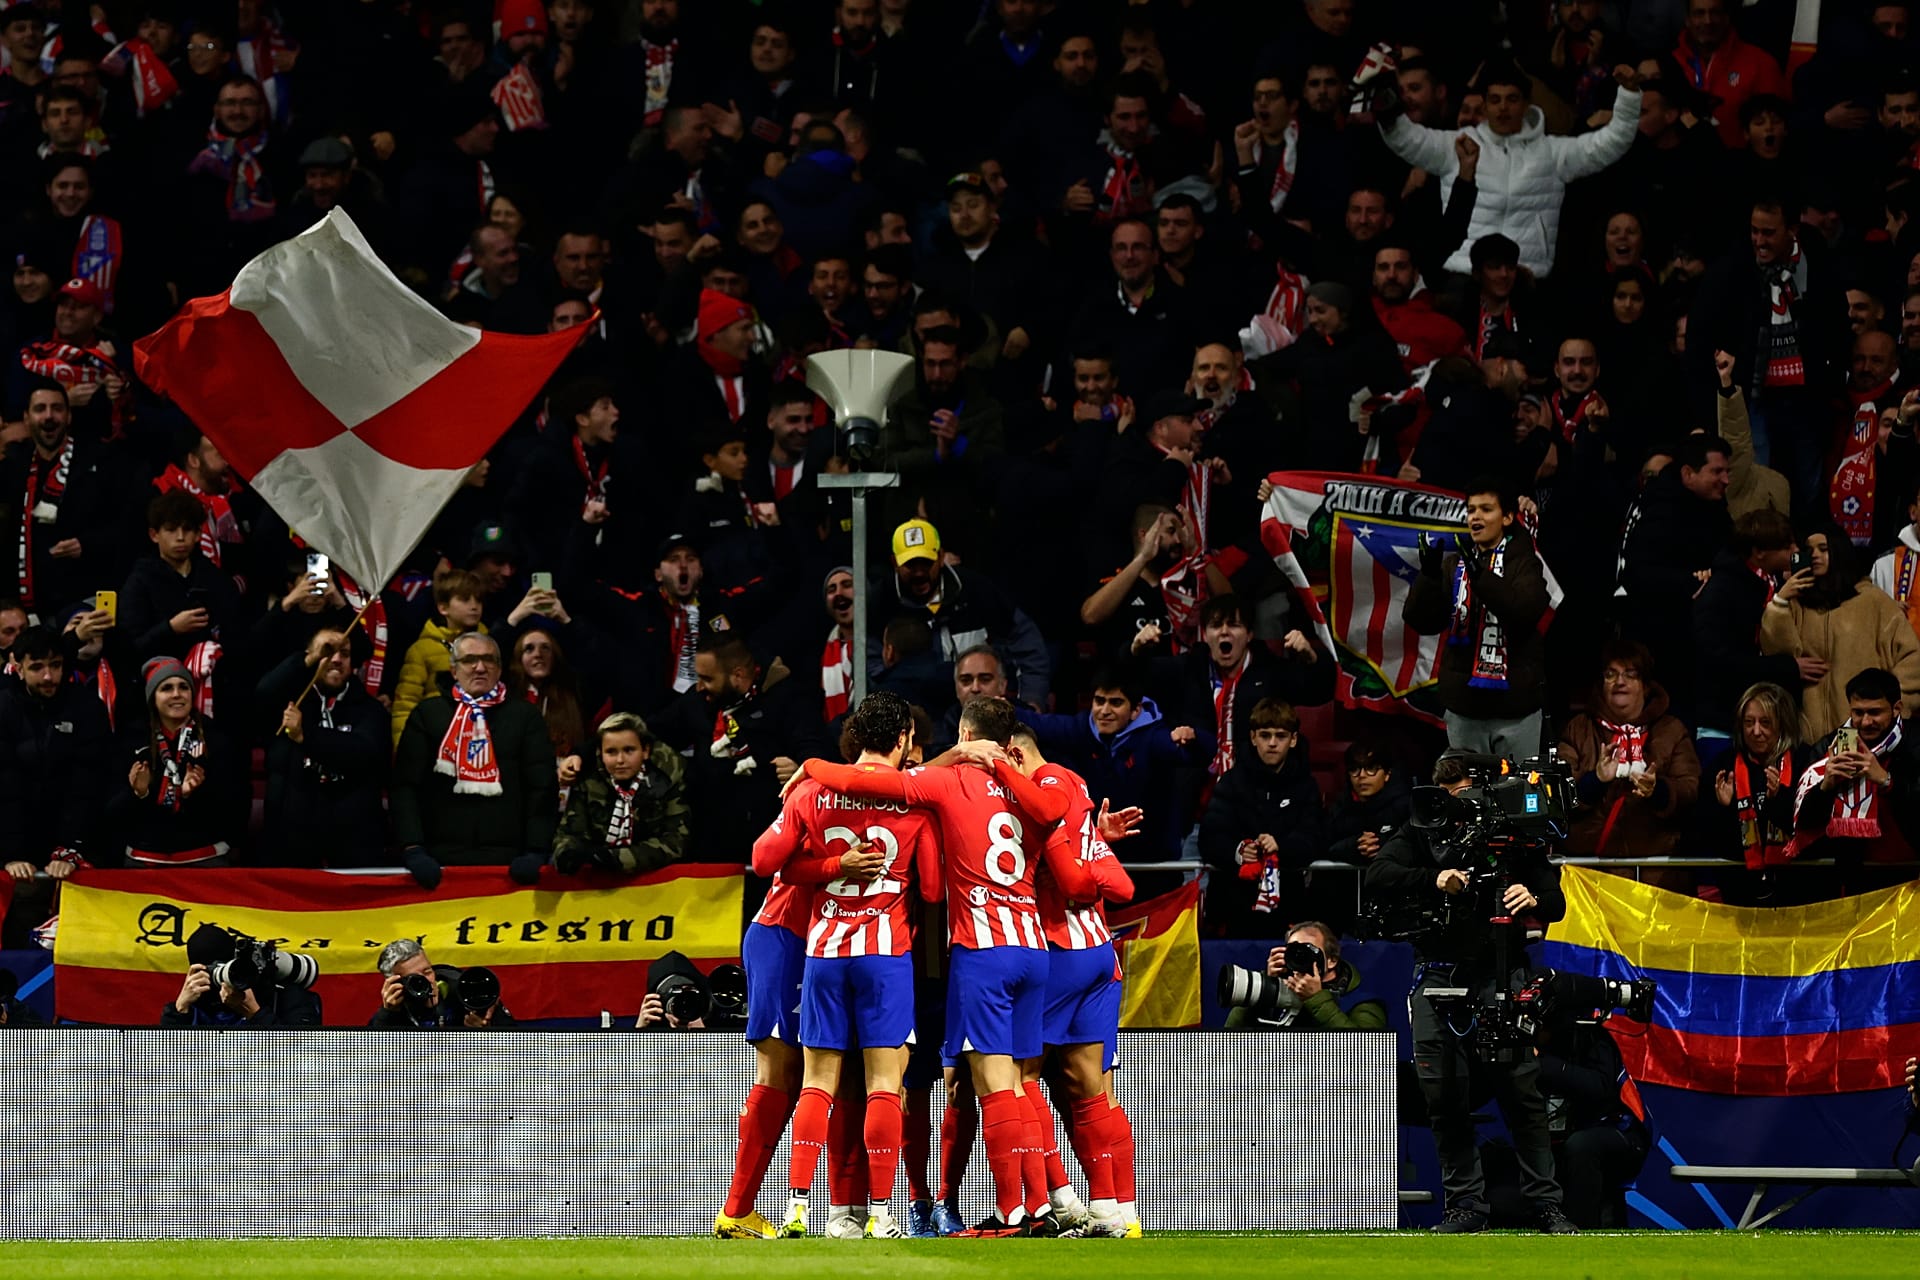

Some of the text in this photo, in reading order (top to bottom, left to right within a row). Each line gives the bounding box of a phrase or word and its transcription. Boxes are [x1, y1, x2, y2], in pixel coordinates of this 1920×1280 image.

[823, 825, 901, 897] 22
[984, 811, 1026, 887] 8
[455, 916, 676, 945] fresno
[838, 908, 857, 918] Save
